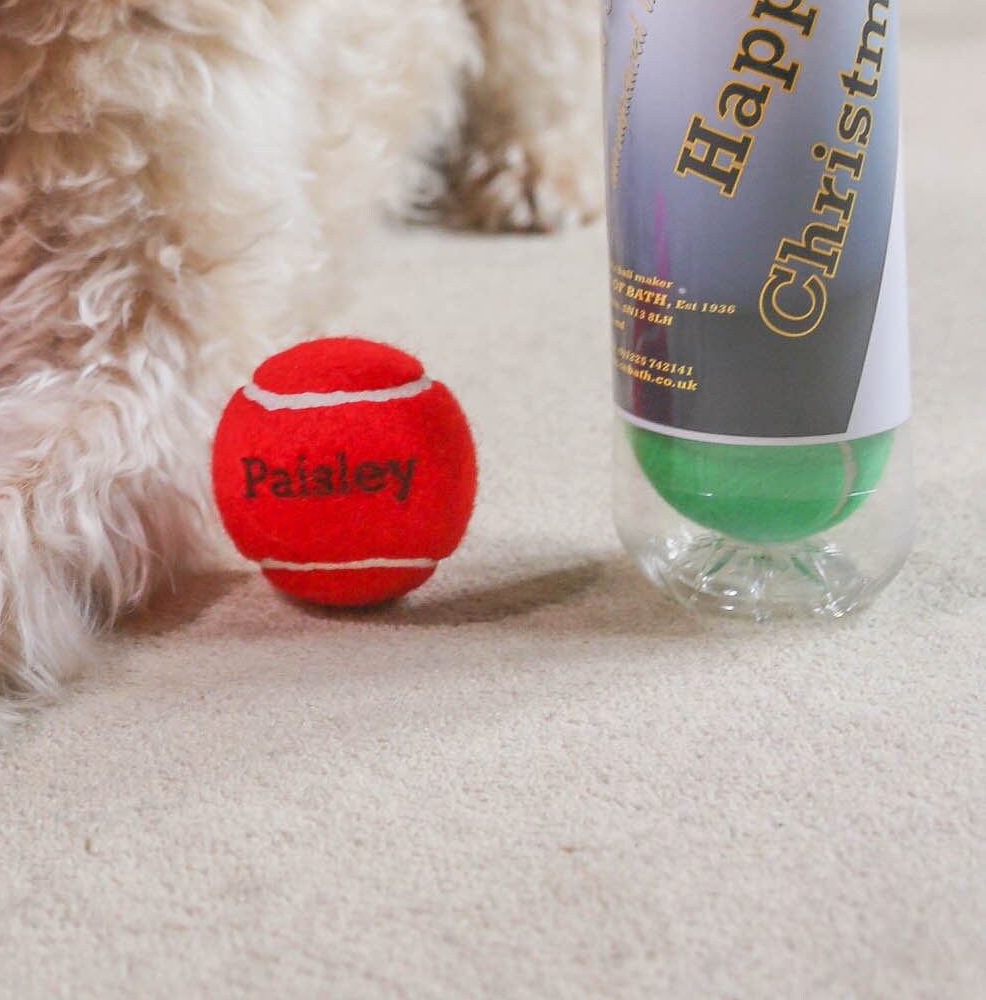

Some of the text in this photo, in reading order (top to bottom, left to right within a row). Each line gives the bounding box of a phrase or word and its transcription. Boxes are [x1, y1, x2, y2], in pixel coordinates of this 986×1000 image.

[634, 272, 674, 289] maker
[626, 284, 672, 309] BATH,
[675, 300, 698, 312] Est
[701, 302, 736, 315] 1936
[648, 358, 694, 377] 742141
[240, 452, 419, 504] Paisley
